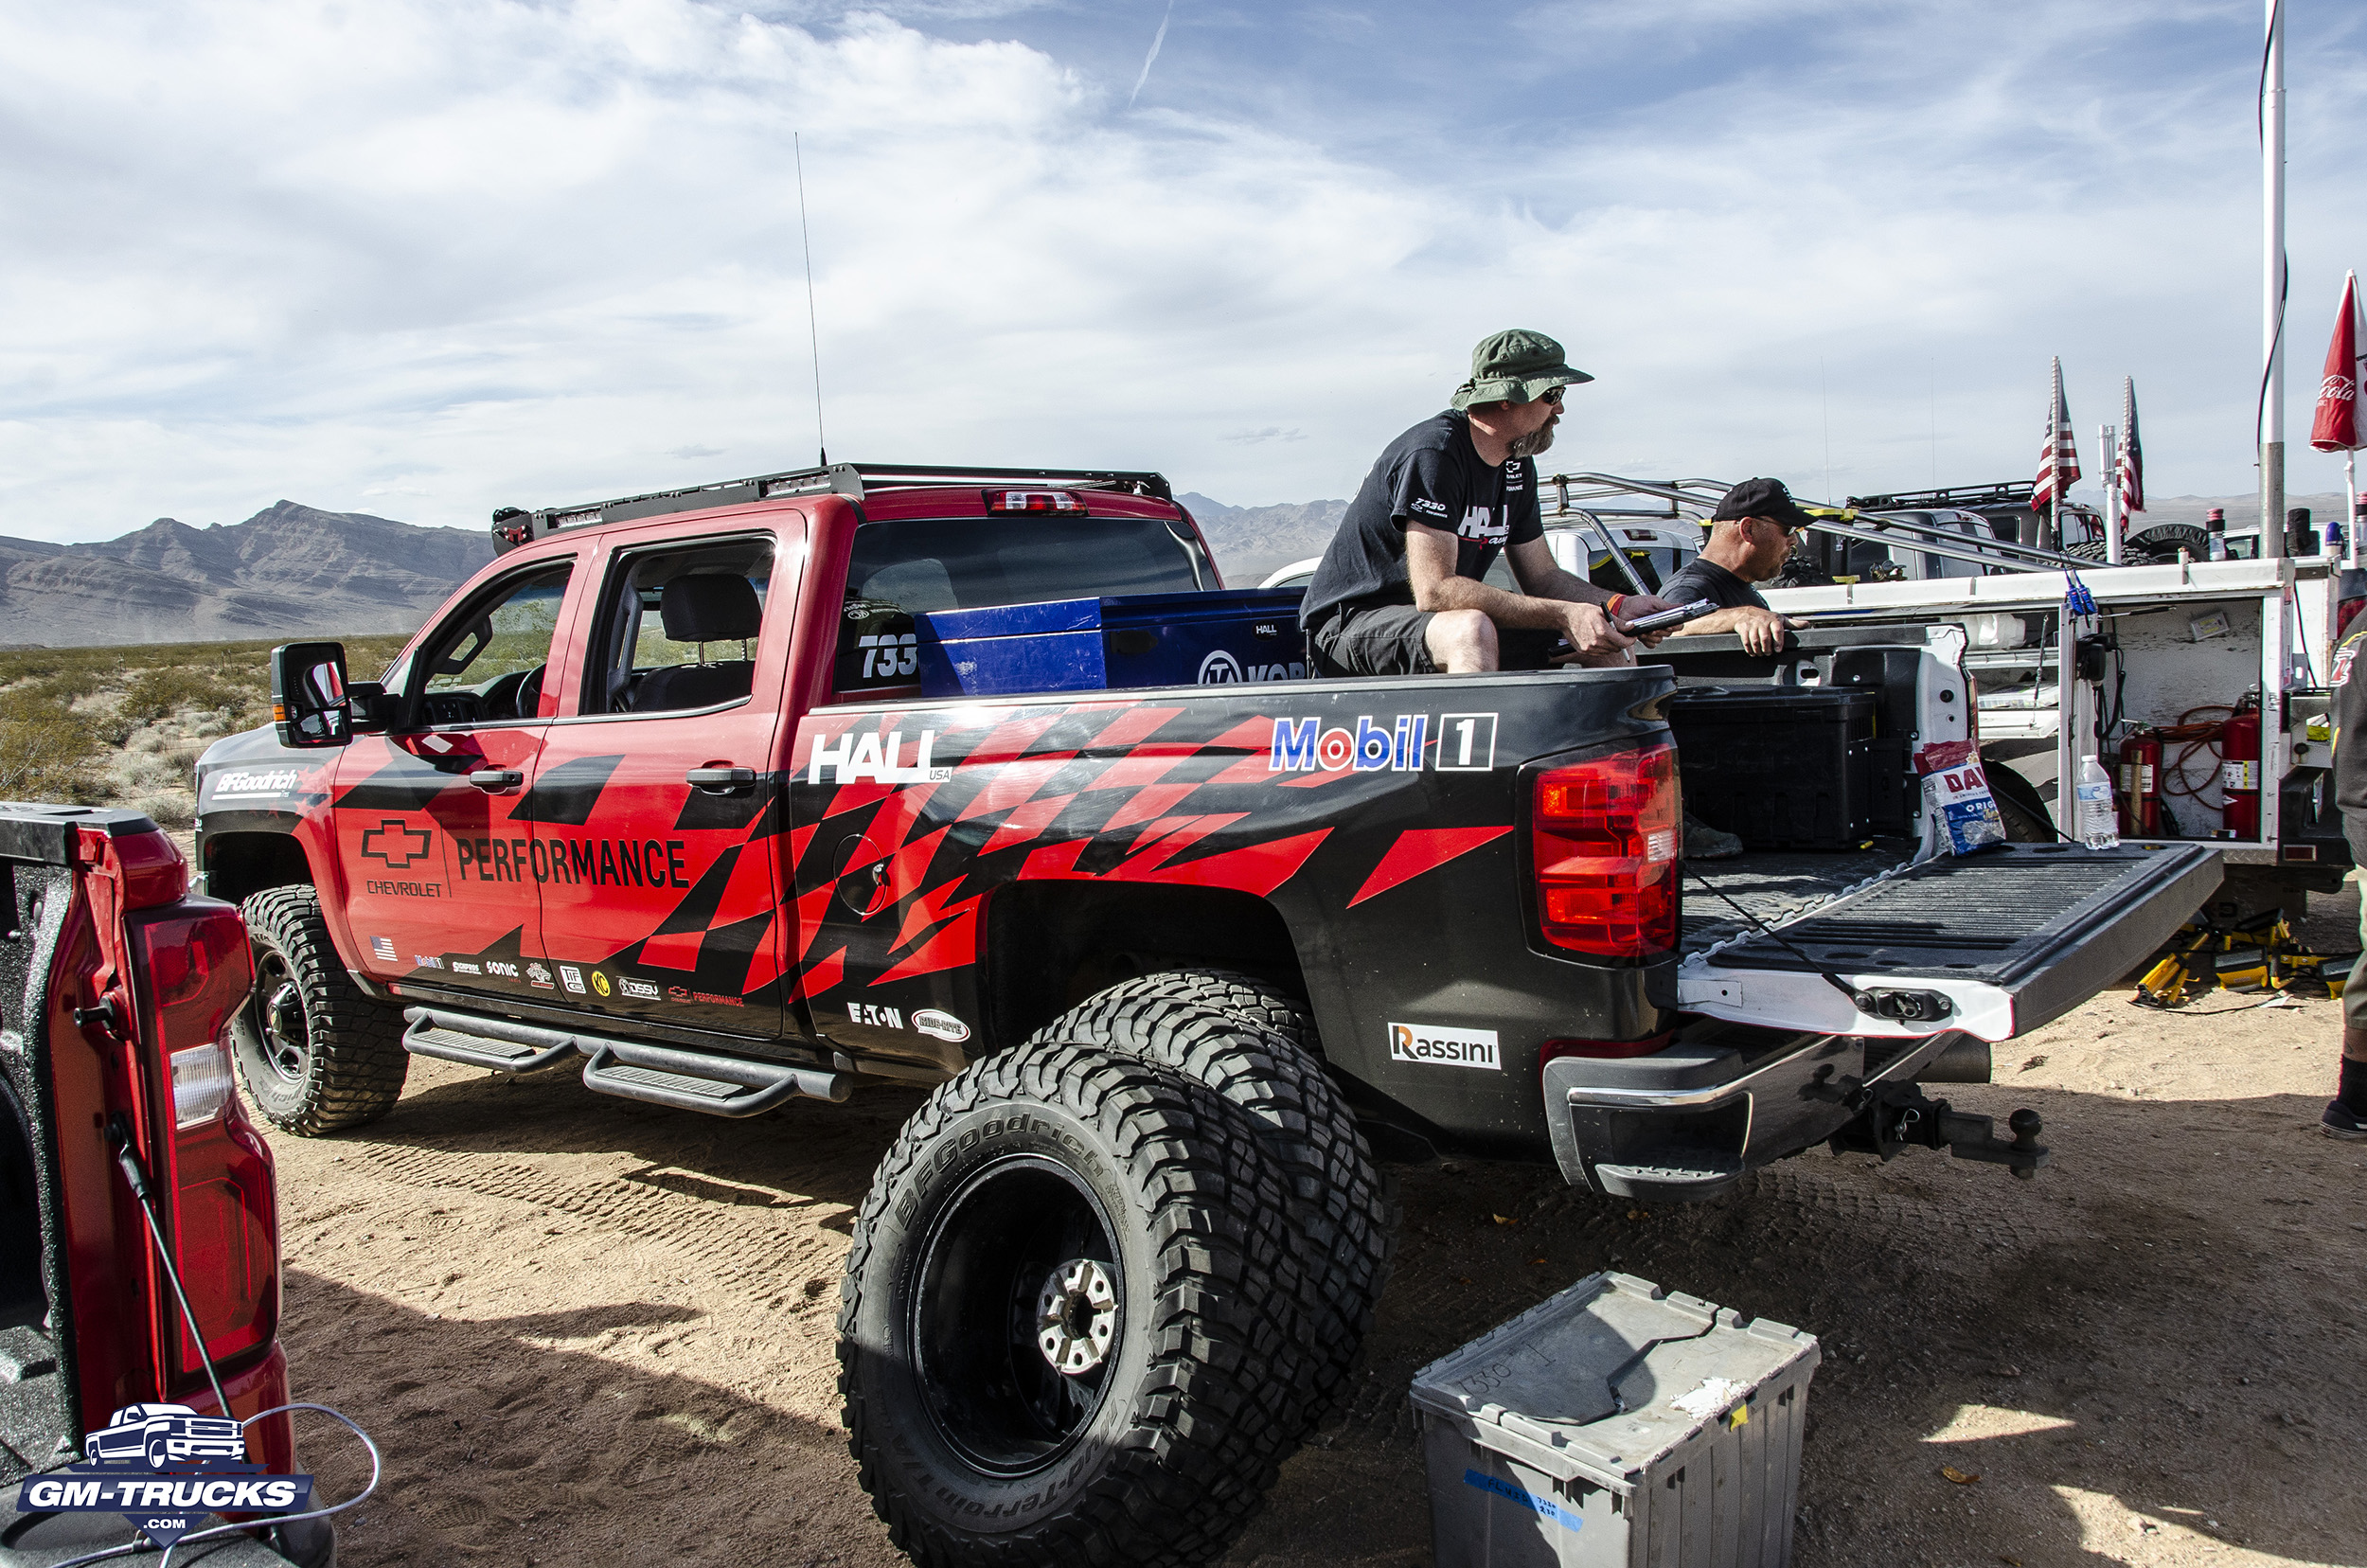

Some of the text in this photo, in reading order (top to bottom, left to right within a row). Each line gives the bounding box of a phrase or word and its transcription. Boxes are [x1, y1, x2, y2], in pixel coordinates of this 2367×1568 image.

[1415, 497, 1447, 511] 7330
[1255, 624, 1277, 635] HALL
[1267, 713, 1429, 772] Mobil
[807, 729, 952, 785] HALL USA
[214, 769, 298, 793] BFGoodrich
[457, 836, 690, 888] PERFORMANCE
[366, 880, 442, 899] CHEVROLET
[594, 973, 609, 995] KC
[692, 991, 745, 1007] PERFORMANCE
[846, 1002, 904, 1030] EATON
[1392, 1025, 1493, 1063] Rassini
[894, 1112, 1105, 1231] BFGoodrich
[1487, 1478, 1529, 1503] FLUID
